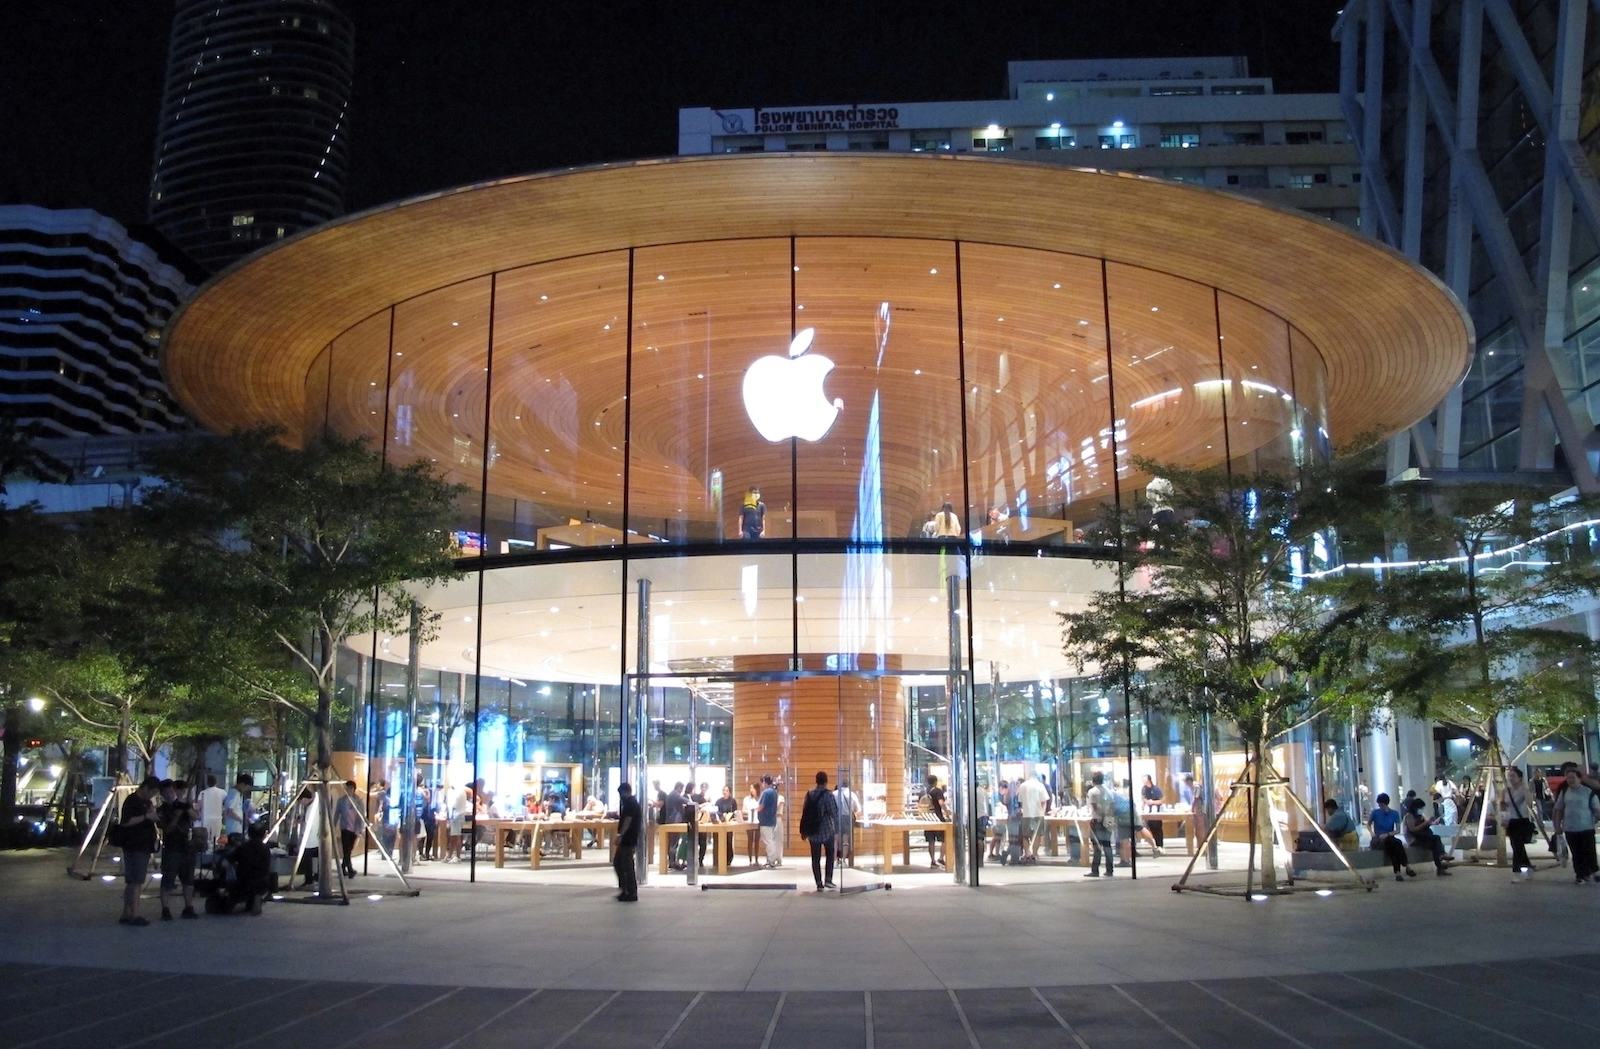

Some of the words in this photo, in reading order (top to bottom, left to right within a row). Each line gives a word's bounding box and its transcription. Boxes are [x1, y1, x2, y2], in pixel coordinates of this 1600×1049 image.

[754, 104, 899, 124] โรงพยาบาลตำรวจ
[754, 124, 793, 133] POLICE
[796, 122, 845, 131] GENERAL
[848, 120, 899, 129] HOSPITAL
